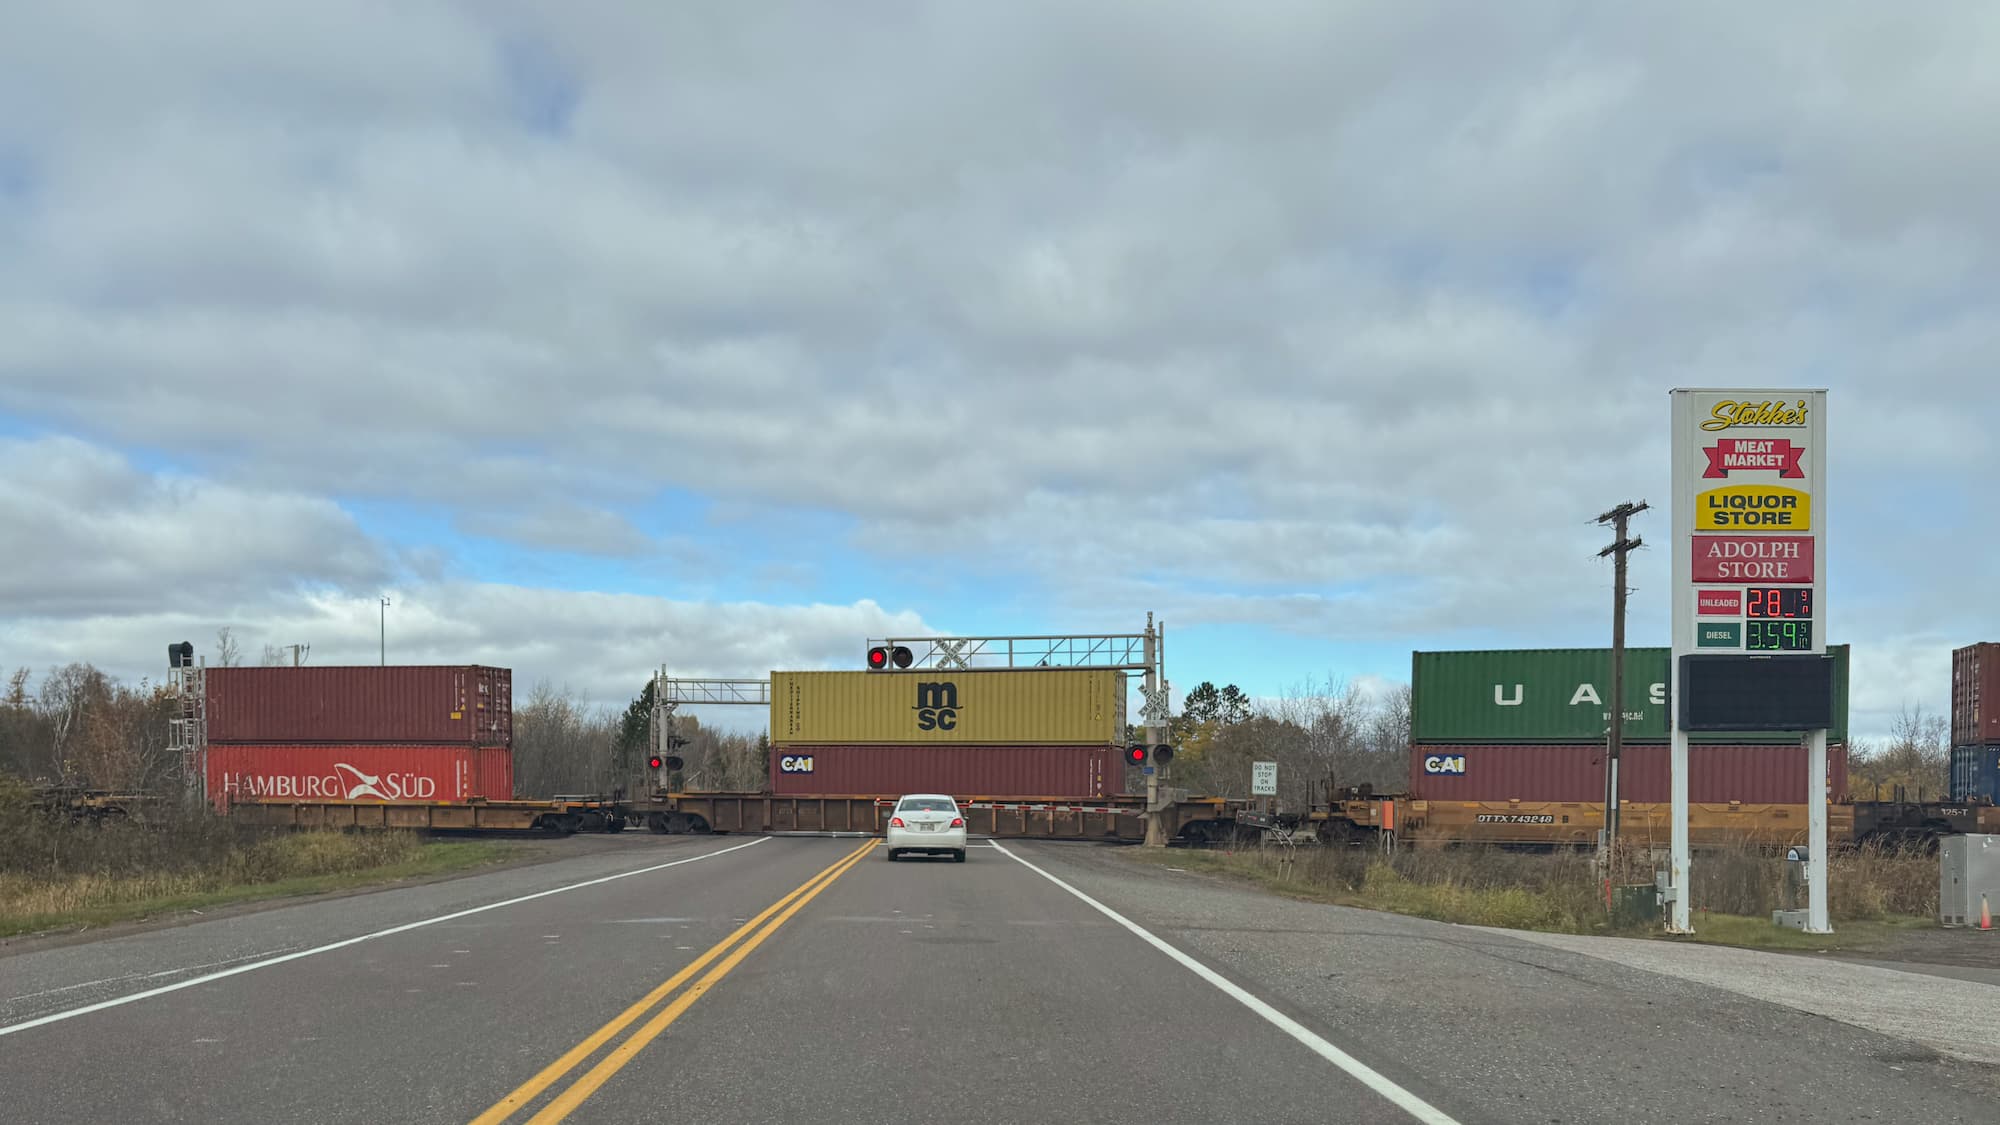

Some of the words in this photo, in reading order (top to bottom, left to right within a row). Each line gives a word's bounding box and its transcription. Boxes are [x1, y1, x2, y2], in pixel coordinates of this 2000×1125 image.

[1700, 400, 1808, 431] Stokke's
[1735, 440, 1774, 453] MEAT
[1724, 454, 1785, 467] MARKET
[1709, 495, 1797, 511] LIQUOR
[1713, 511, 1792, 525] STORE
[1707, 541, 1800, 558] ADOLPH
[1718, 562, 1789, 578] STORE
[1700, 598, 1739, 607] UNLEADED
[1706, 631, 1733, 640] DIESEL
[1749, 622, 1796, 649] 3.59
[781, 756, 814, 772] CAI
[1424, 756, 1466, 773] CAI
[224, 772, 338, 797] HAMBURG
[386, 773, 435, 799] SÜD
[1478, 815, 1508, 823] DTTX
